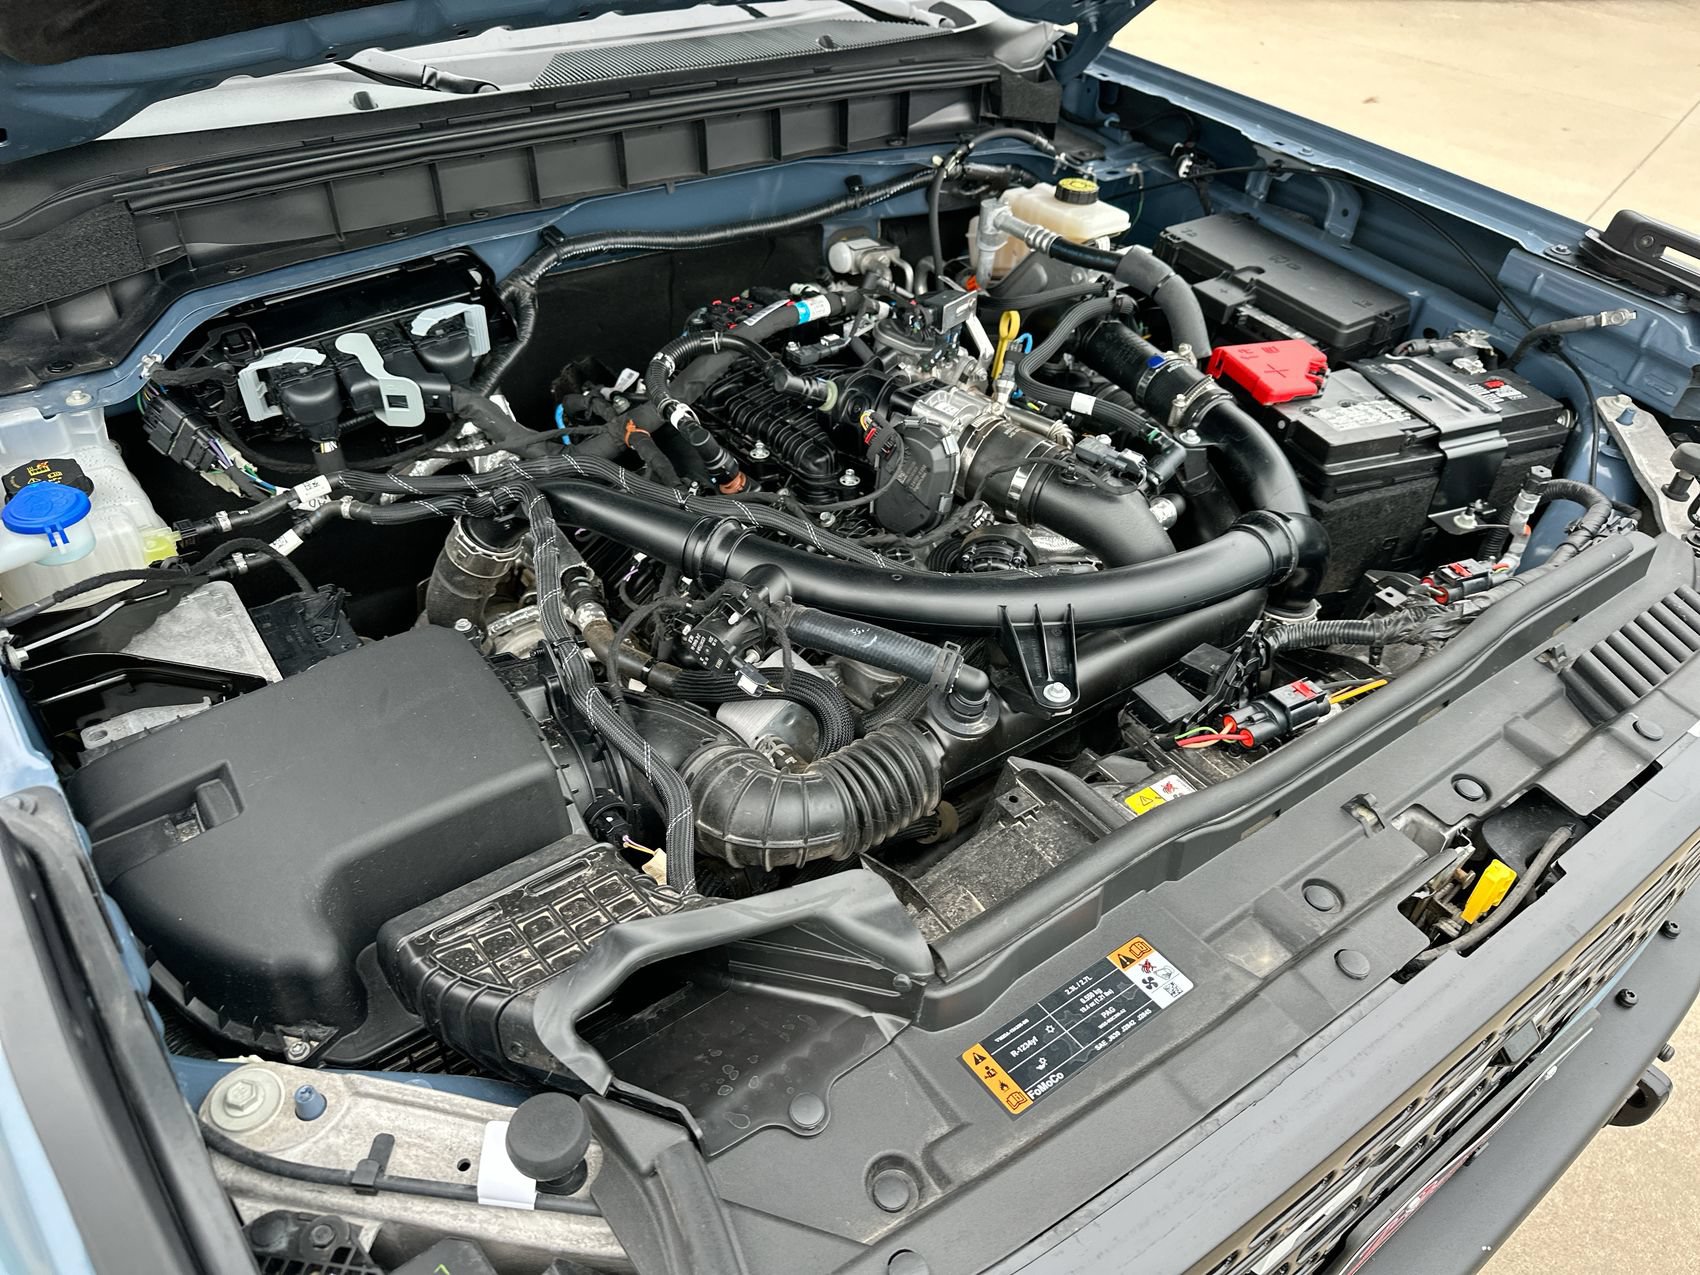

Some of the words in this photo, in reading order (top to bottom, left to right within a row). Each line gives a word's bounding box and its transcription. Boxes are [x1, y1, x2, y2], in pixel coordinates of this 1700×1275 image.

[1100, 1006, 1116, 1019] PAG
[1009, 1035, 1039, 1058] R-1234yf
[1094, 1039, 1109, 1051] SAE
[1026, 1072, 1065, 1100] FoMoCo
